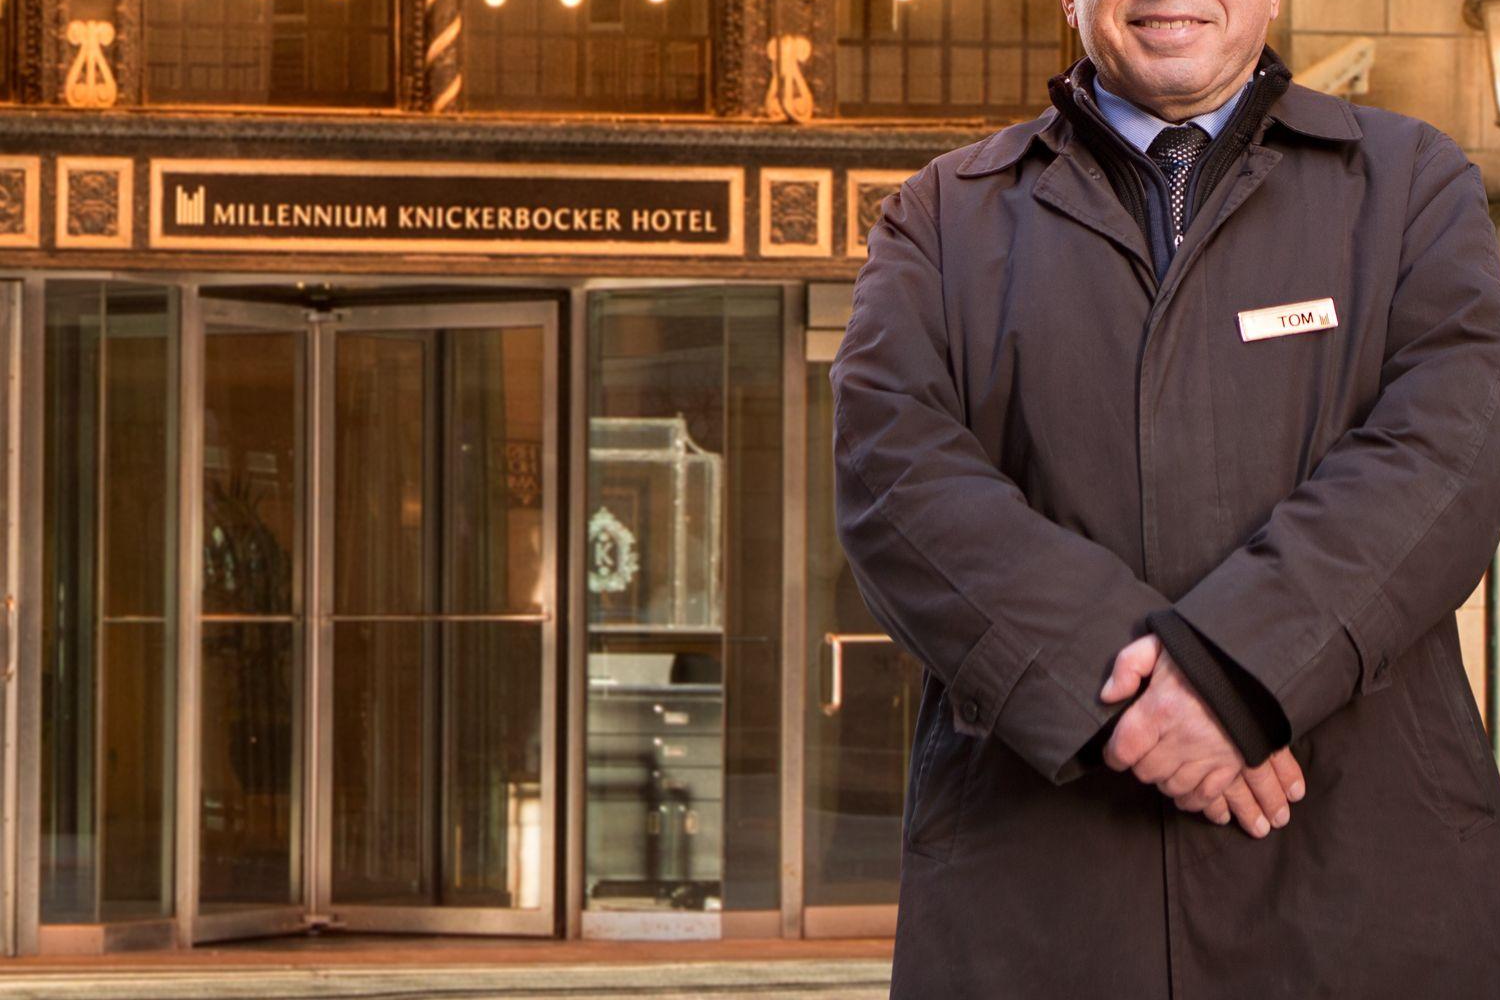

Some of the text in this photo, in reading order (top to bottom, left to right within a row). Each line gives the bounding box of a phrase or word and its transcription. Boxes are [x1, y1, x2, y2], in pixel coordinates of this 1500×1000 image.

[213, 203, 717, 233] MILLENNIUM KNICKERBOCKER HOTEL
[1277, 312, 1314, 328] TOM
[595, 542, 614, 566] K
